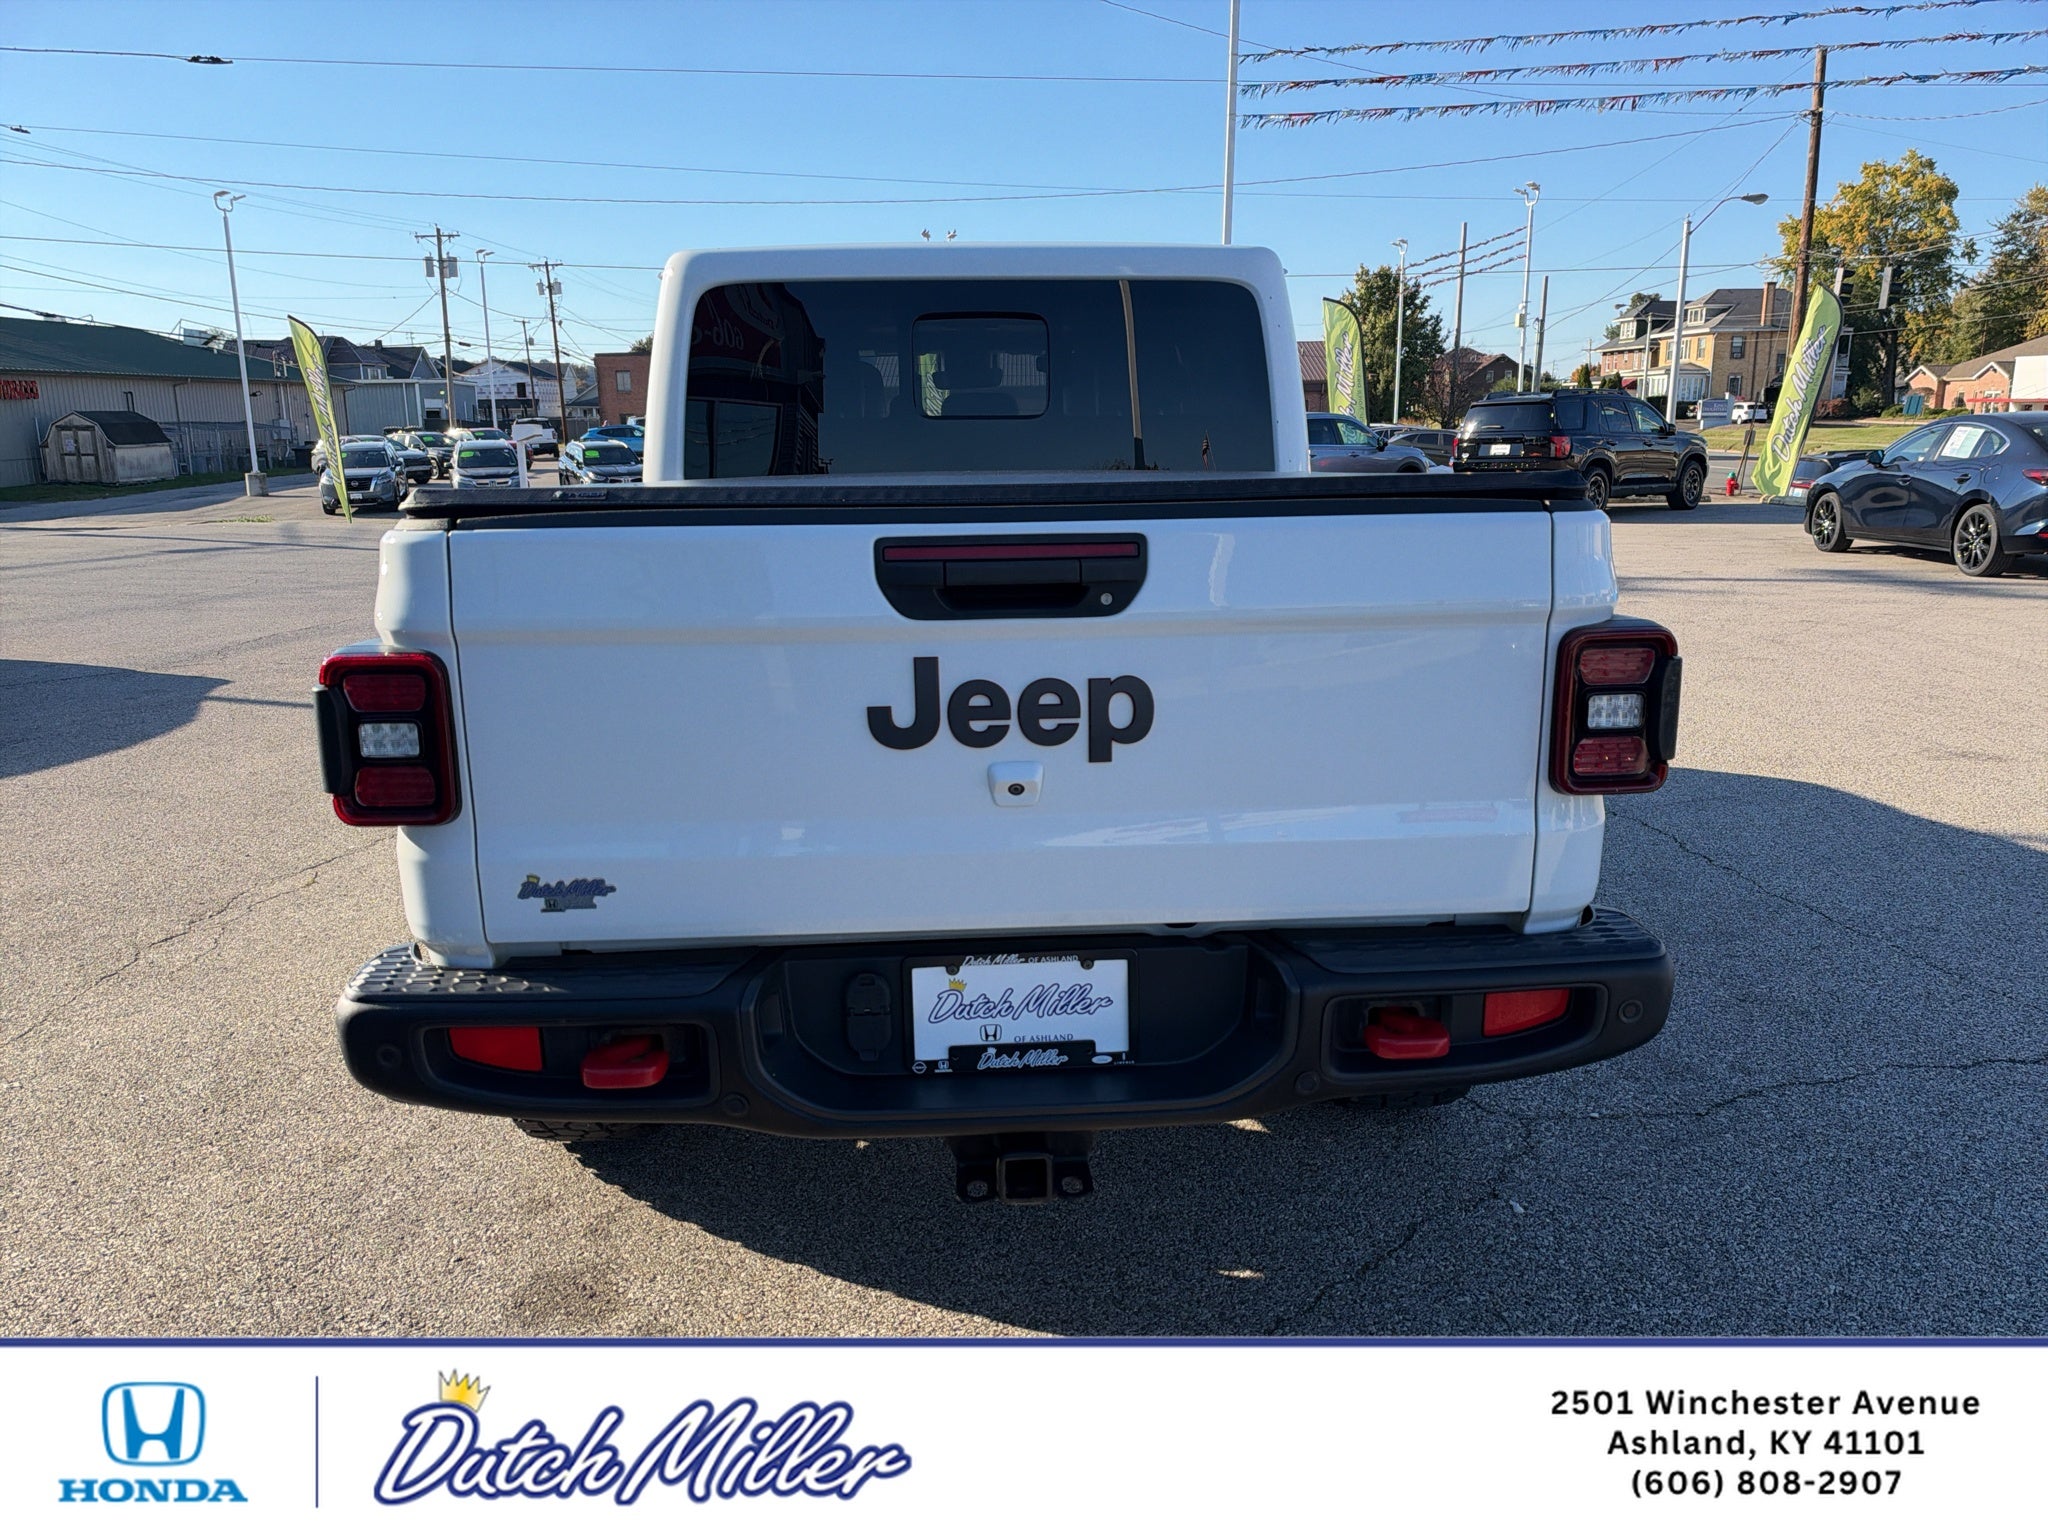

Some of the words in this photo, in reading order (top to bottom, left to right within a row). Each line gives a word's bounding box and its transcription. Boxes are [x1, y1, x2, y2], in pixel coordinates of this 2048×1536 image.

[1334, 331, 1357, 404] Miller
[1771, 396, 1804, 464] Dutch
[1790, 324, 1827, 403] Miller
[866, 656, 1154, 763] Jeep
[962, 954, 993, 966] Dutch
[992, 953, 1025, 965] Miller
[1041, 954, 1079, 963] ASHLAND
[928, 987, 1015, 1024] Dutch
[1012, 983, 1114, 1020] Miller
[1014, 1035, 1028, 1043] OF
[1030, 1033, 1073, 1042] ASHLAND
[976, 1050, 1021, 1070] Dutch
[1018, 1048, 1069, 1068] Miller
